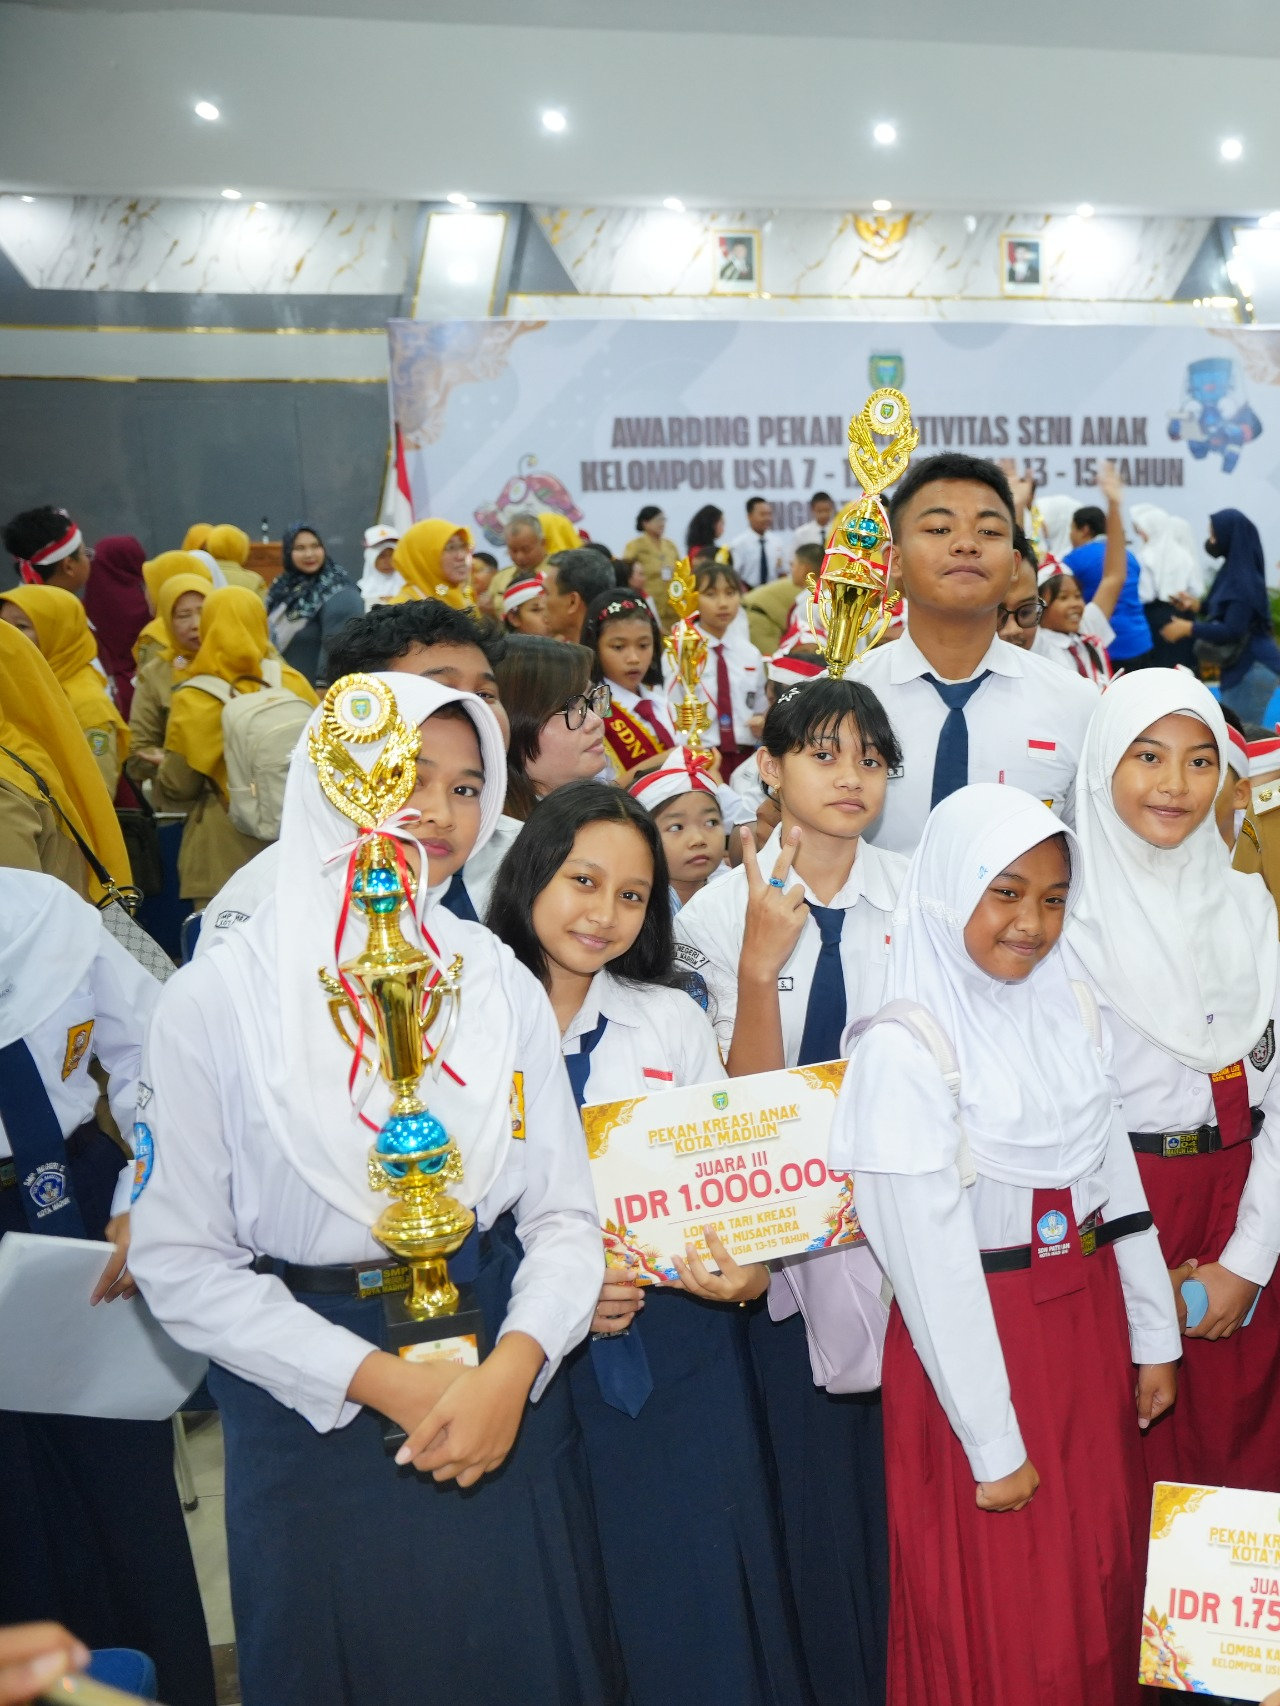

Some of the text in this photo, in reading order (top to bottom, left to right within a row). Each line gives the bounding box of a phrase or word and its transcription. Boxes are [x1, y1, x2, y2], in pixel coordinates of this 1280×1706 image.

[612, 416, 749, 448] AWARDING
[759, 416, 843, 446] PEKAN
[1018, 416, 1072, 446] SENI
[1081, 416, 1147, 446] ANAK
[581, 460, 725, 491] KELOMPOK
[734, 459, 794, 489] USIA
[803, 459, 816, 489] 7
[1074, 458, 1099, 487] 15
[610, 718, 647, 759] SDN
[648, 1103, 799, 1145] PEKAN KREASI ANAK
[675, 1122, 779, 1154] KOTA MADIUN
[694, 1150, 768, 1179] JUARA III
[614, 1189, 671, 1226] IDR
[729, 1214, 754, 1229] TARI
[757, 1206, 797, 1224] KREASI
[731, 1231, 811, 1257] USIA 13-15 TAHUN
[732, 1220, 800, 1243] NUSANTARA
[382, 1266, 409, 1278] SMP
[1208, 1526, 1261, 1548] PEKAN
[1231, 1546, 1268, 1564] KOTA
[1169, 1587, 1221, 1624] IDR
[1219, 1642, 1262, 1659] LOMBA
[1211, 1656, 1263, 1673] KELOMPOK
